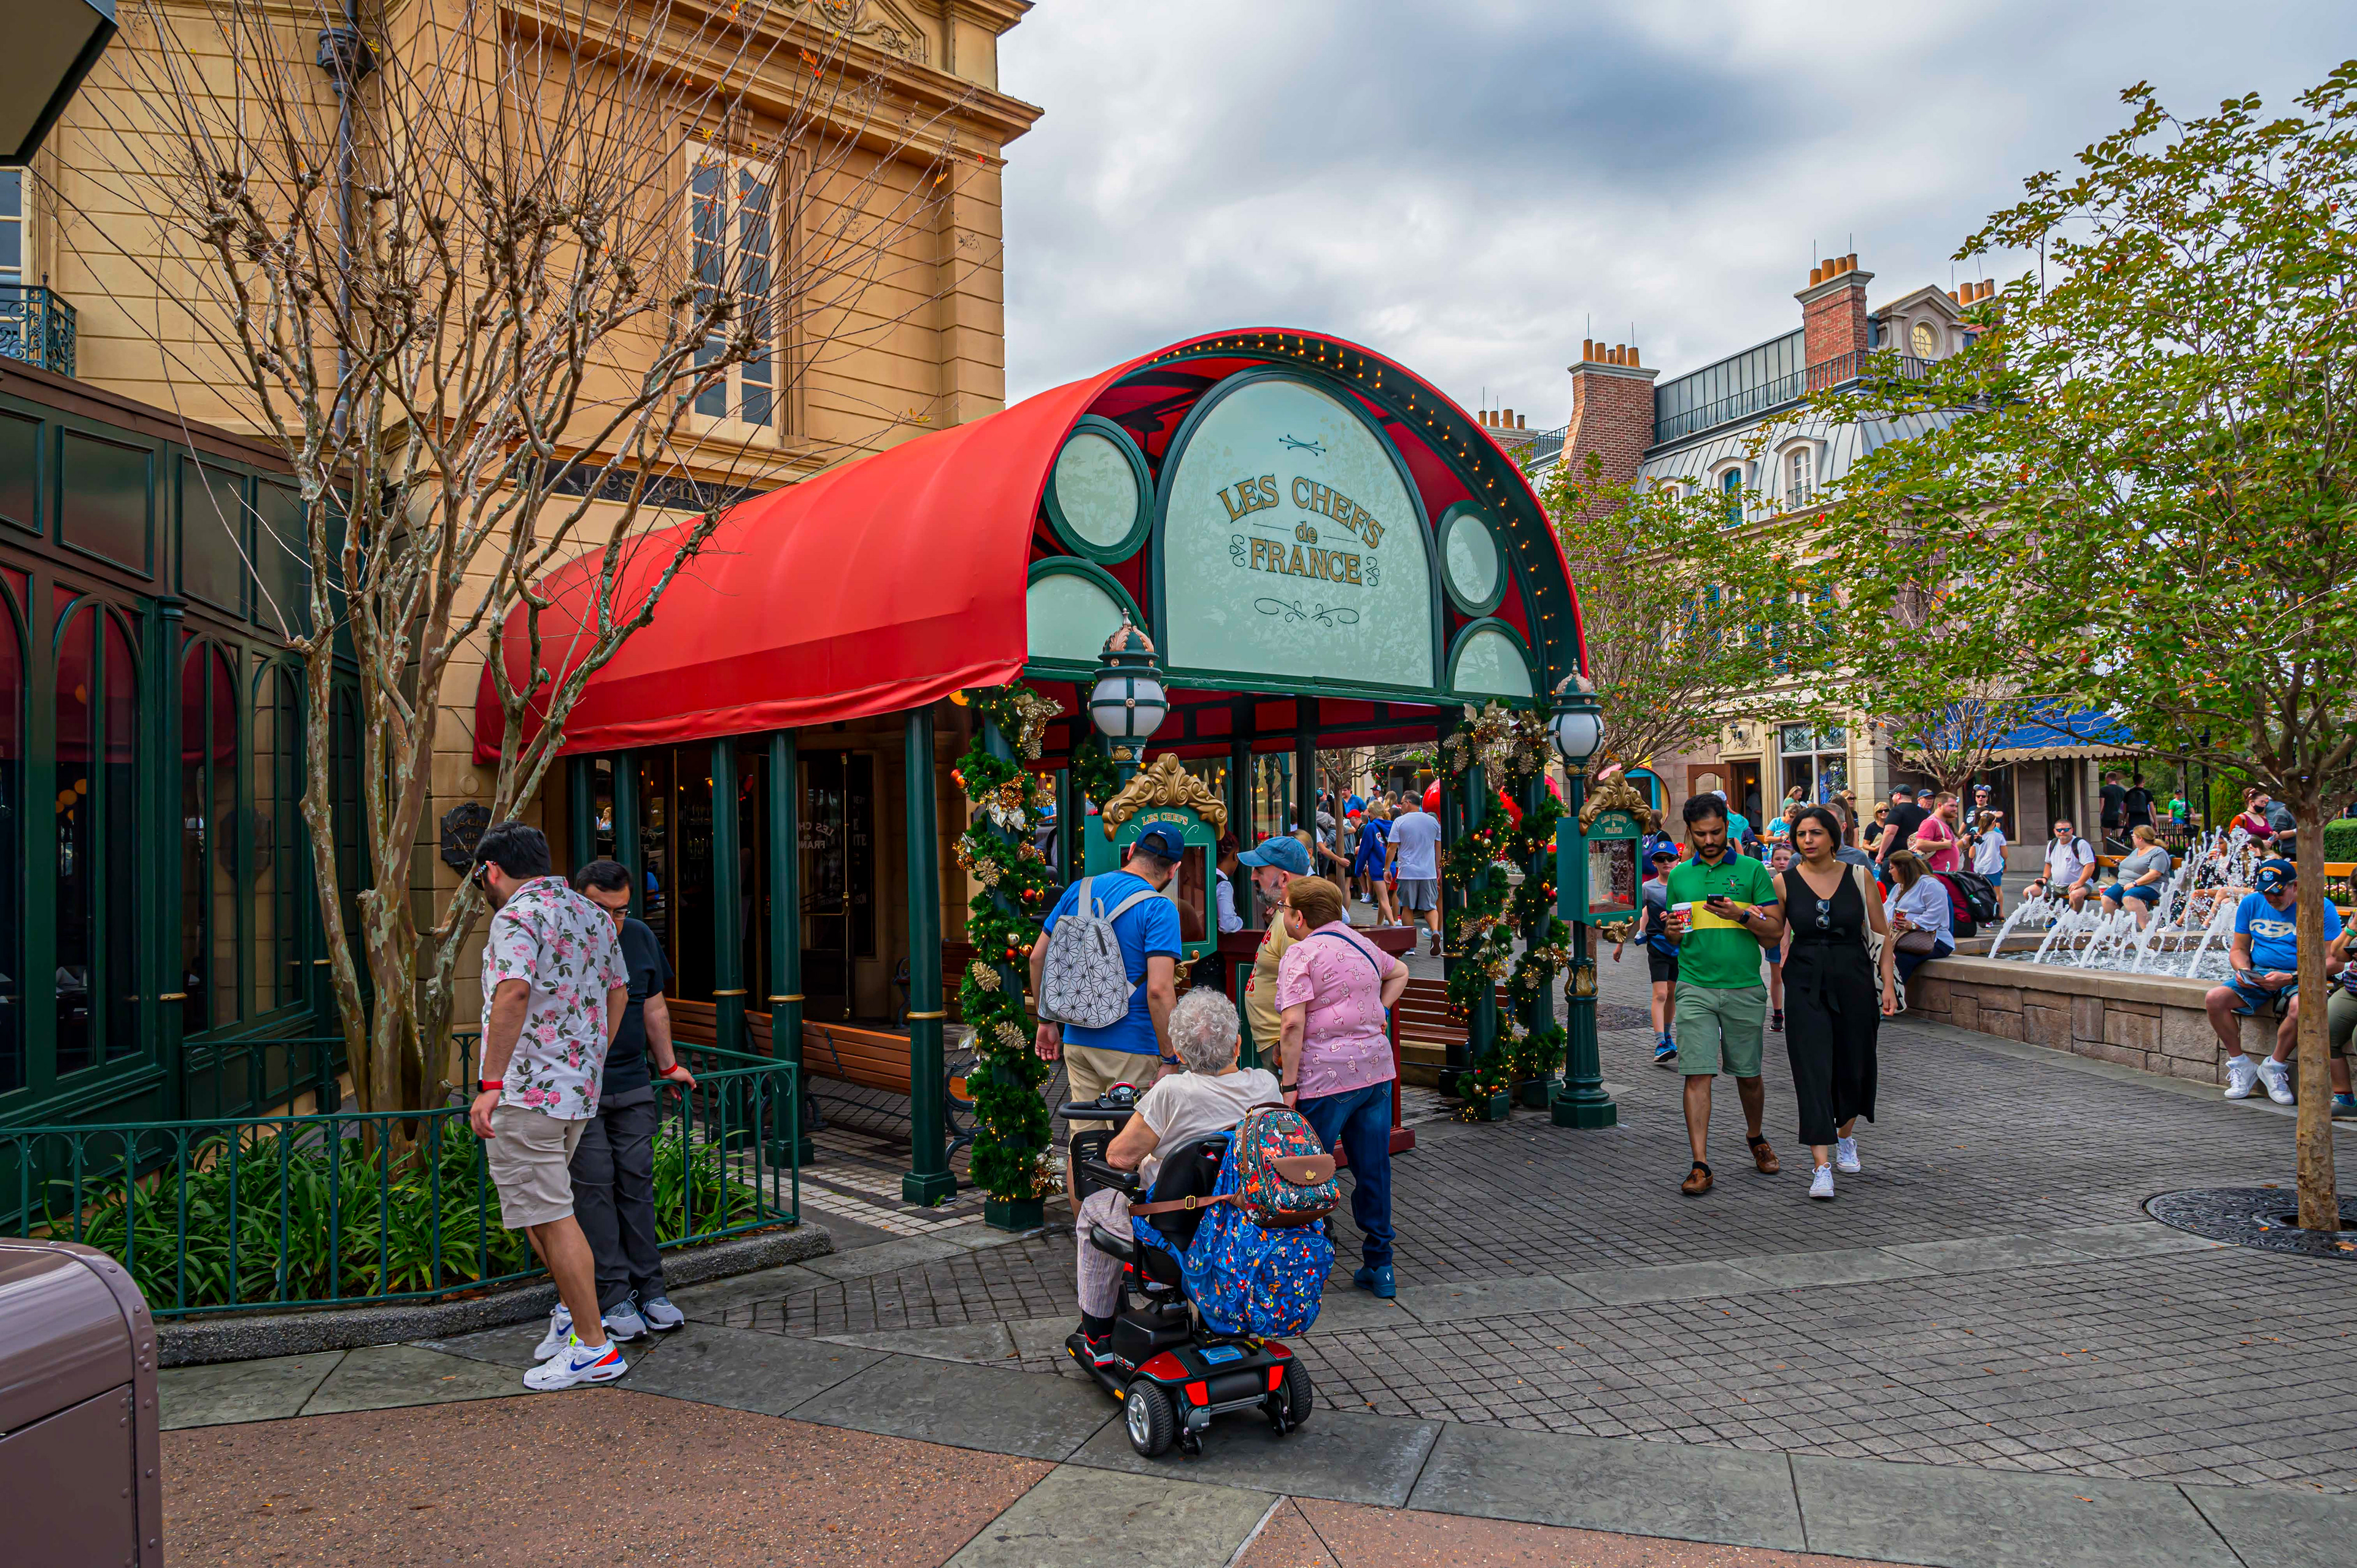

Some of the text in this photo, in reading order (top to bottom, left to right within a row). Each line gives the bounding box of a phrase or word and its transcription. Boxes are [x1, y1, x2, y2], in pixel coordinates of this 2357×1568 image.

[1217, 474, 1385, 549] LES CHEFS
[1295, 521, 1318, 544] de
[1248, 536, 1362, 586] FRANCE
[467, 818, 488, 829] Che
[1142, 812, 1188, 825] LES CHEFS
[452, 843, 477, 851] Fran
